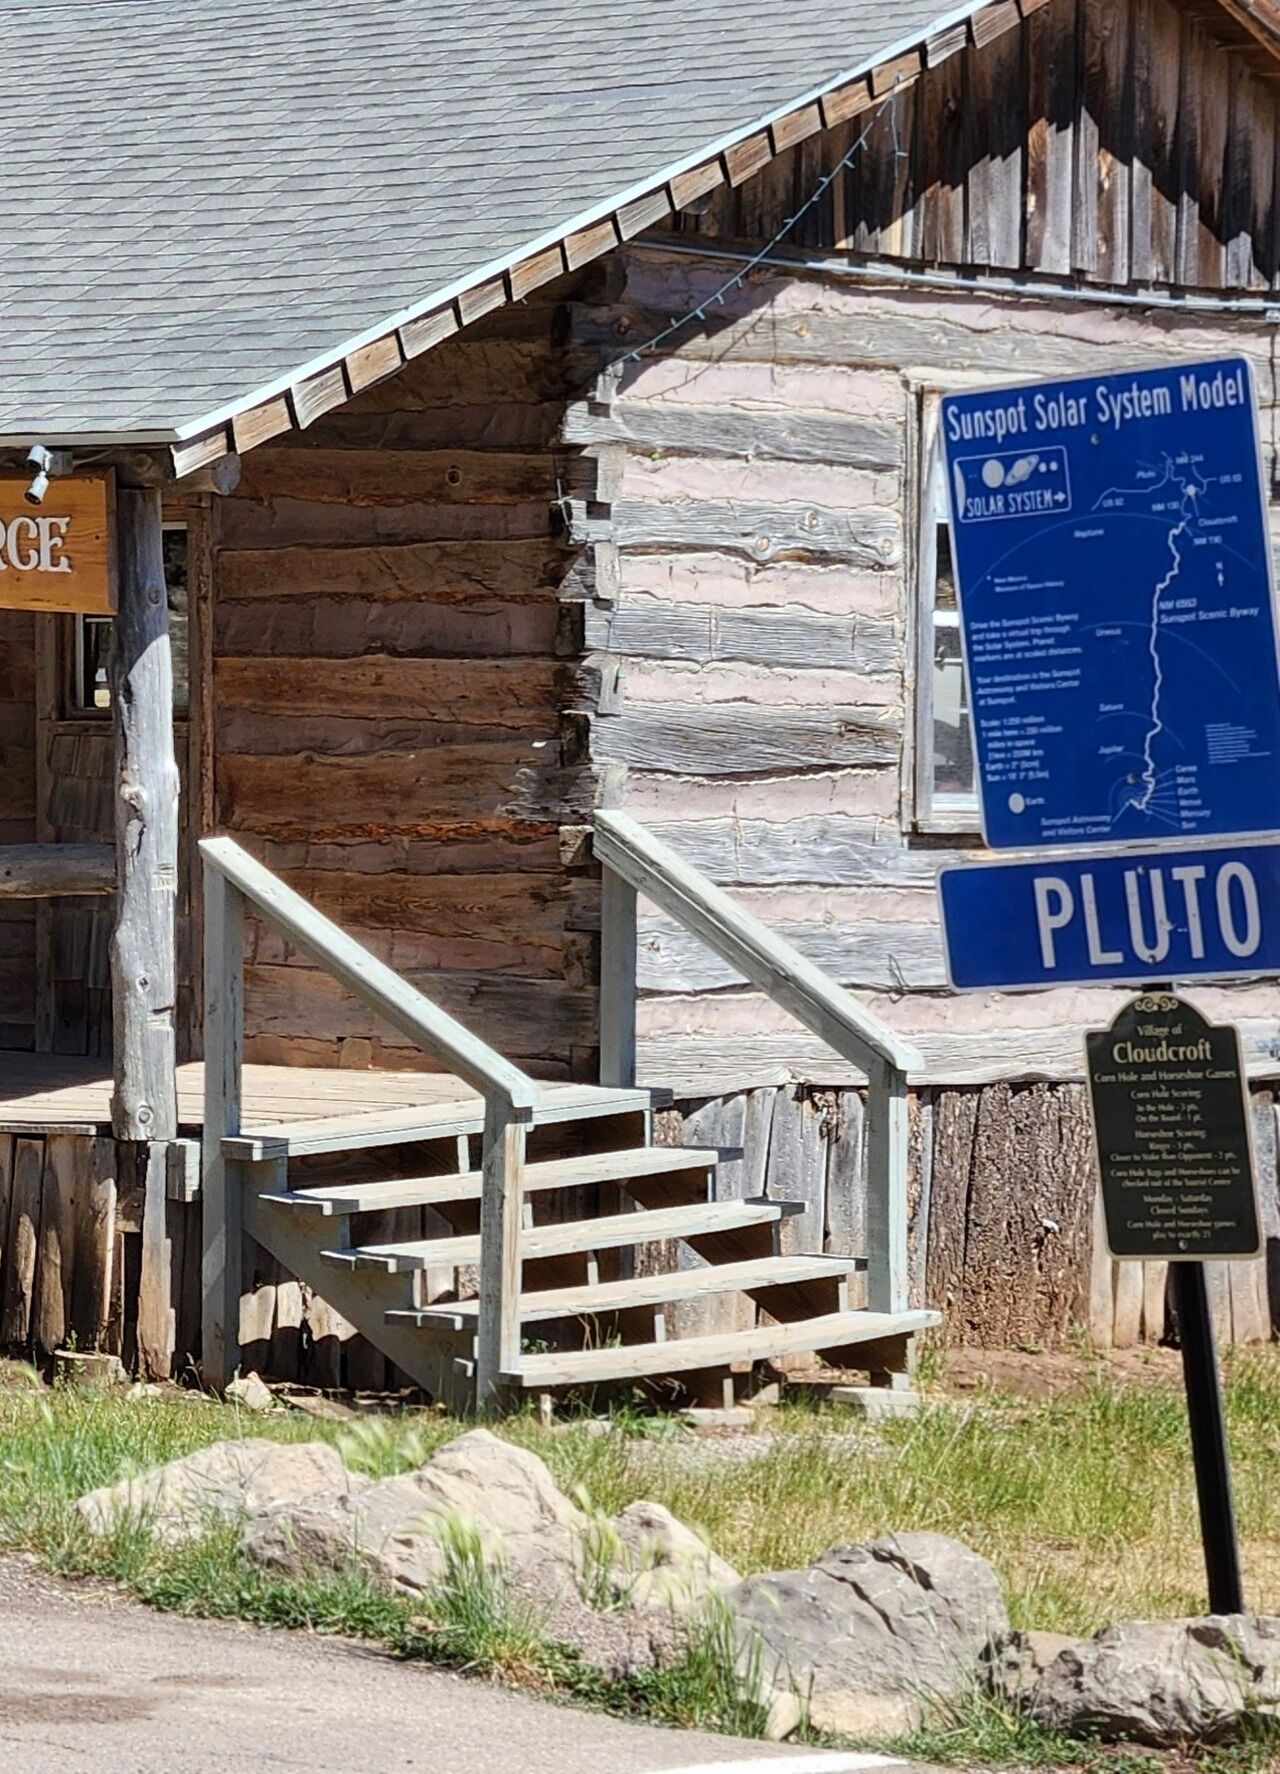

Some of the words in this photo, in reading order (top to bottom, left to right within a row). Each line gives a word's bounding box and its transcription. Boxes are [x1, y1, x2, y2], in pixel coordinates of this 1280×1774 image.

[947, 397, 1027, 443] Sunspot
[1035, 392, 1087, 430] Solar
[1096, 382, 1171, 430] System
[1180, 369, 1244, 412] Model
[966, 494, 1005, 517] SOLAR
[1008, 489, 1053, 513] SYSTEM
[1160, 612, 1196, 624] Sunspot
[1198, 610, 1228, 620] Scenic
[1230, 607, 1260, 618] Byway
[1033, 862, 1261, 968] PLUTO
[1136, 1025, 1169, 1038] Village
[1172, 1024, 1182, 1034] of
[1113, 1038, 1212, 1064] Cloudcroft
[1094, 1073, 1116, 1082] Corn
[1118, 1072, 1138, 1082] Hole
[1140, 1072, 1156, 1080] and
[1158, 1069, 1204, 1080] Horseshoe
[1206, 1068, 1236, 1078] Games
